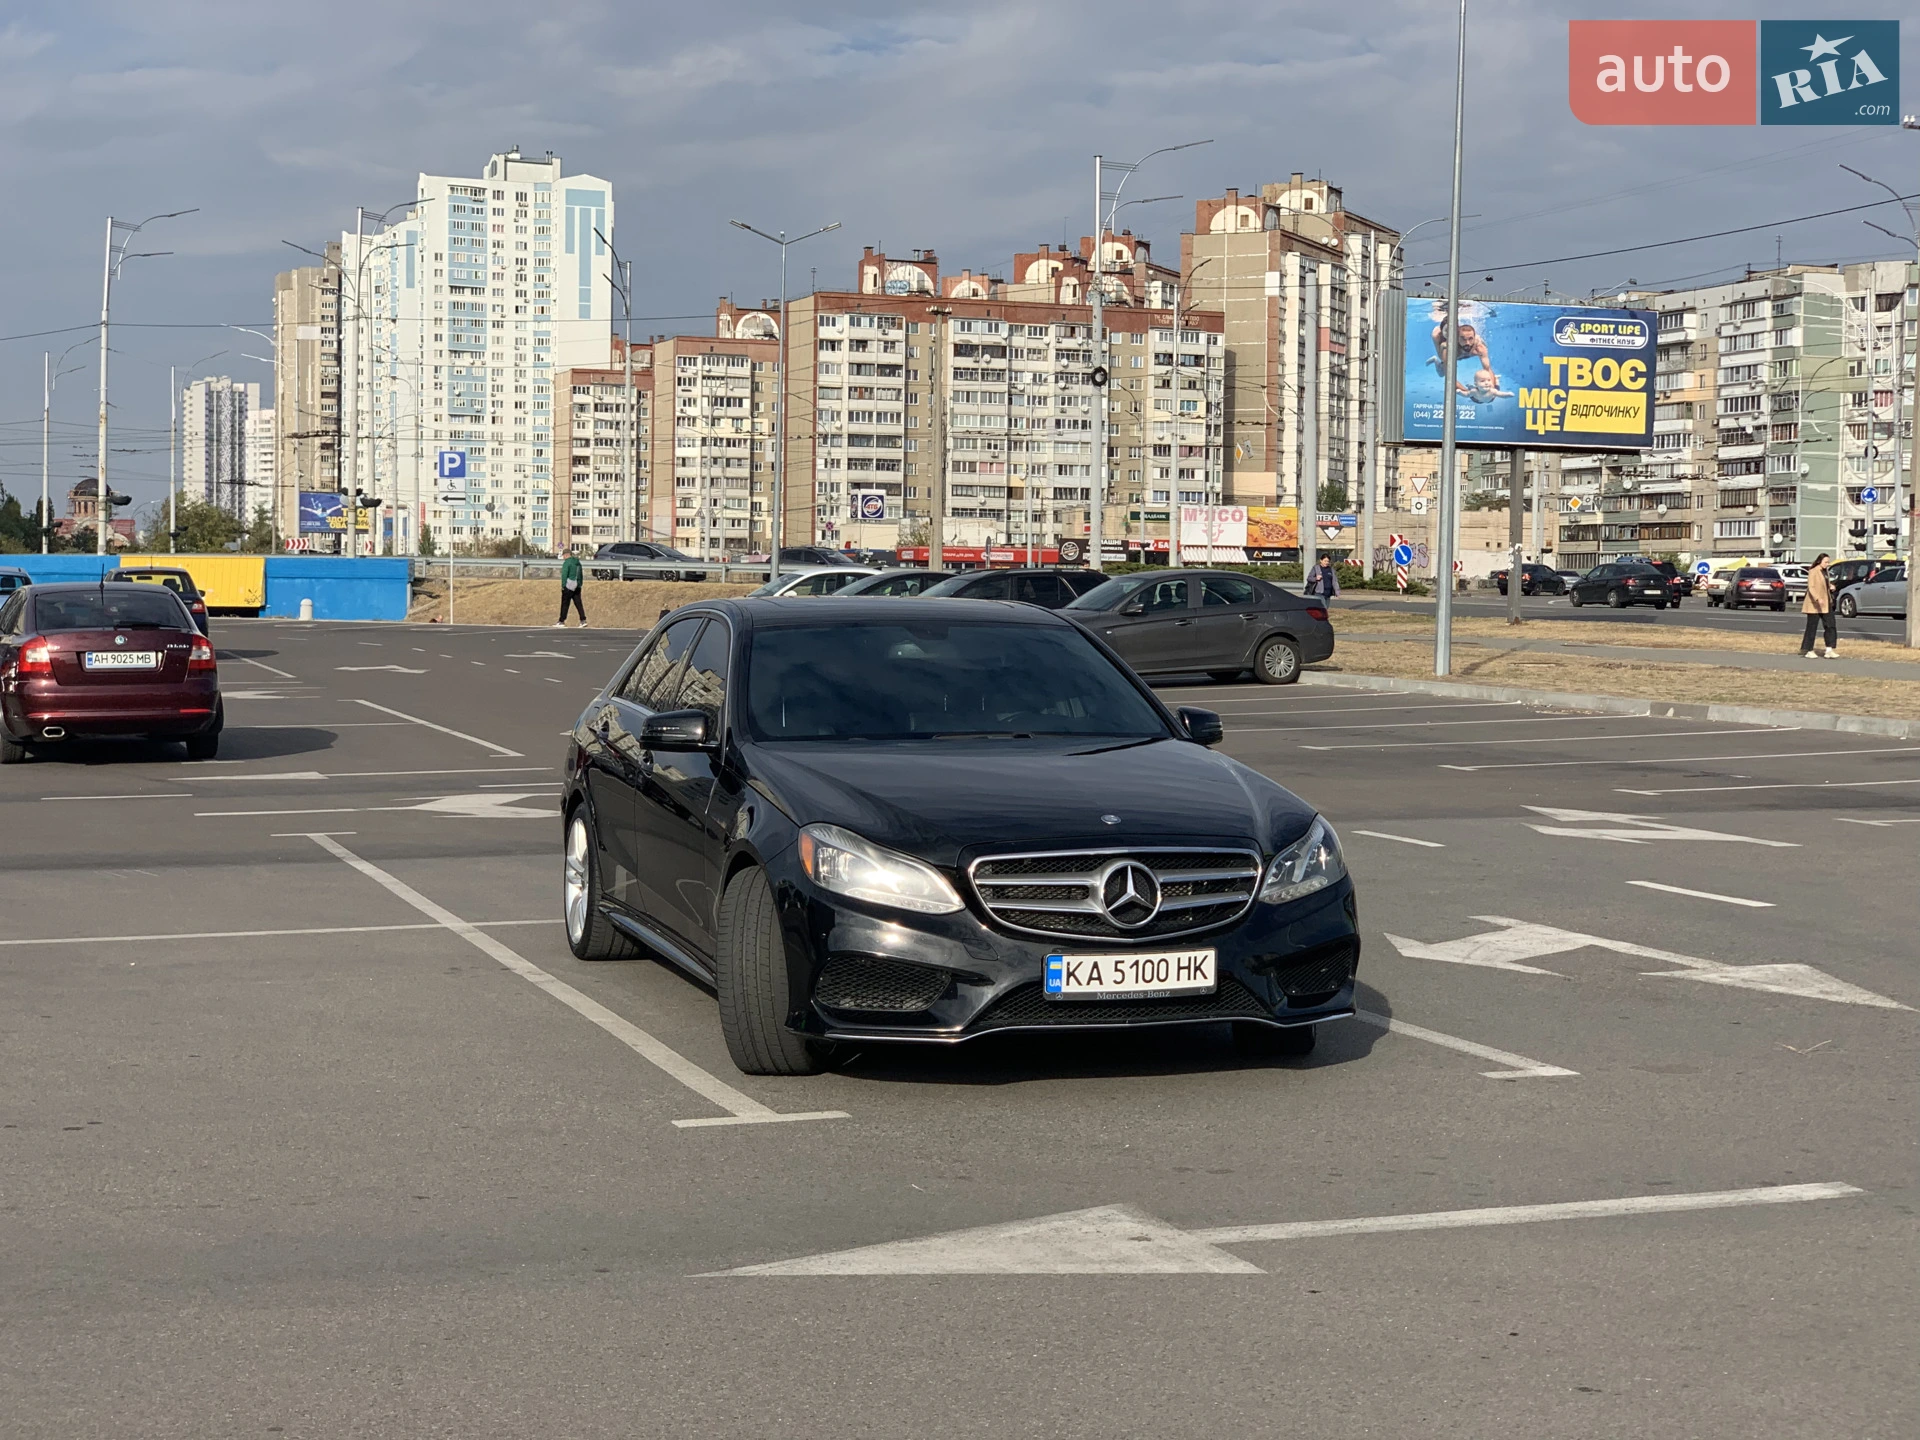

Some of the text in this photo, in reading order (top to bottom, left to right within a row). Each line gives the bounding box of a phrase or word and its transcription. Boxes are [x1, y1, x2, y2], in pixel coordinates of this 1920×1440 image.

[1580, 323, 1641, 336] SPORT LIFE
[1543, 356, 1648, 391] ТВОЄ
[1519, 388, 1567, 410] МІС
[1413, 411, 1431, 419] (044)
[1459, 411, 1476, 420] 222
[1570, 404, 1640, 419] ВІДПОЧИНКУ
[1526, 410, 1561, 436] ЦЕ
[444, 453, 461, 476] P
[94, 654, 151, 664] AH 9025 MB
[1066, 955, 1209, 987] KA 5100 HK
[1049, 978, 1062, 987] UA
[1096, 990, 1171, 1000] Mercedes-Benz
